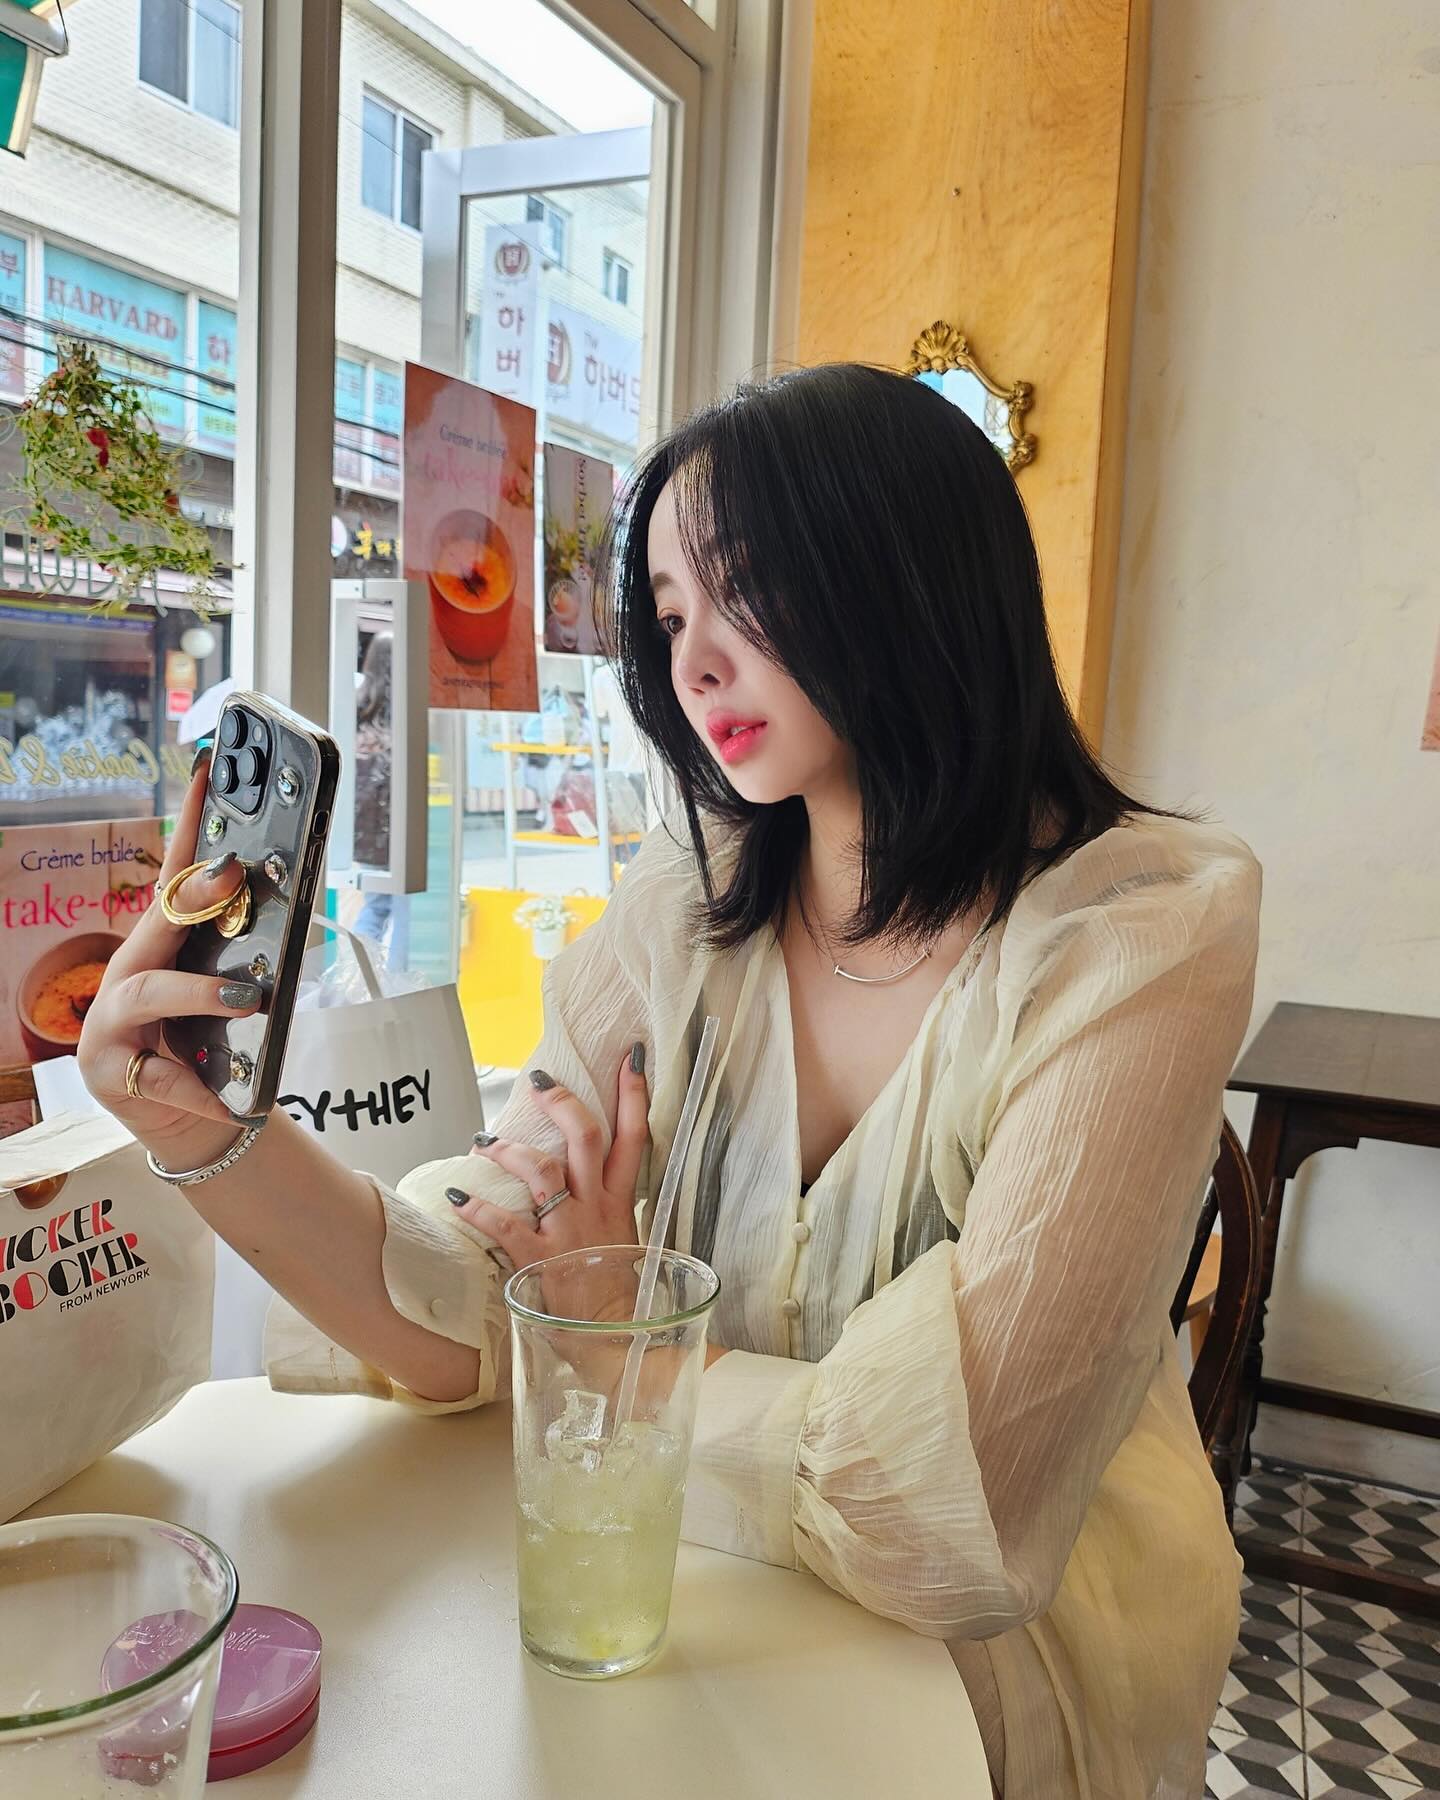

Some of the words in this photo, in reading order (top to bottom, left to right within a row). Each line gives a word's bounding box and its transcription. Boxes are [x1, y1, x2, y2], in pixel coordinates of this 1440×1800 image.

[47, 276, 178, 341] HARVARD
[21, 849, 85, 872] Crème
[91, 837, 145, 865] brûlée
[60, 1291, 93, 1312] FROM
